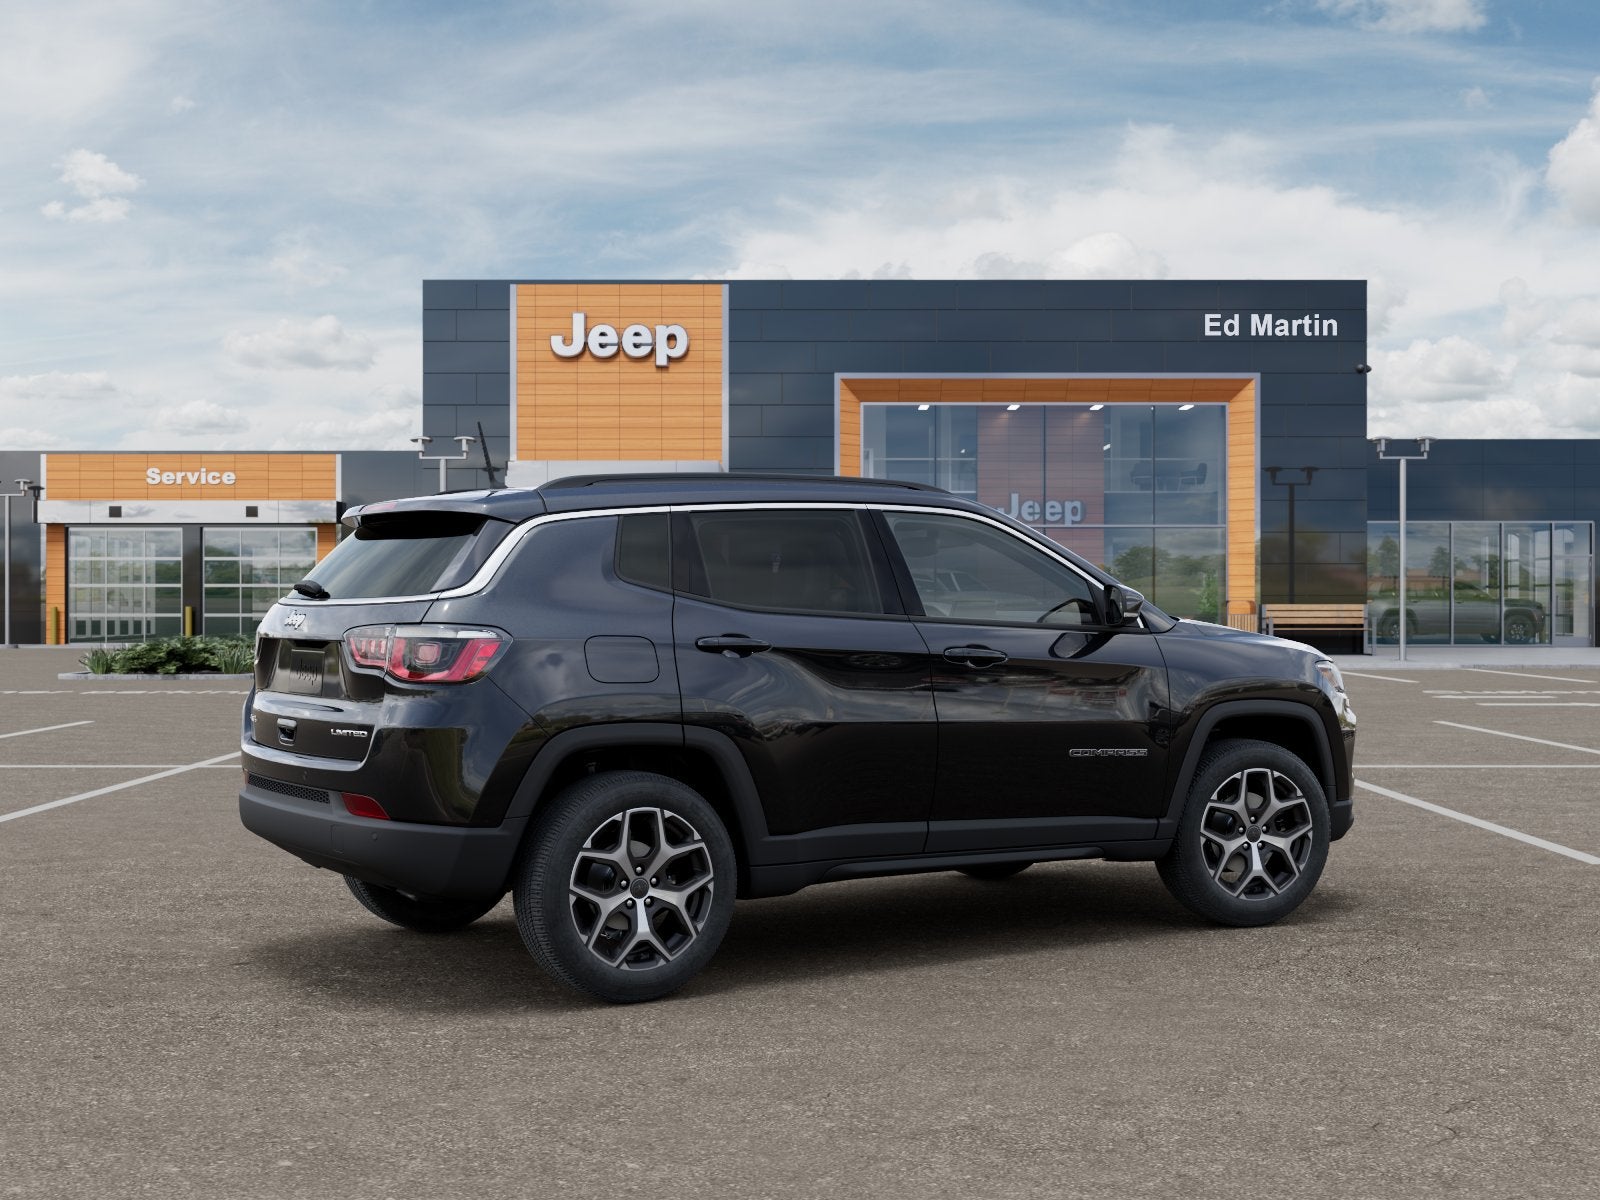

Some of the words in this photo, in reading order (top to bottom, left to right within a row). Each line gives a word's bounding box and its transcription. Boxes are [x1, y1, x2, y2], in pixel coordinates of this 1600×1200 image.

[1204, 313, 1240, 337] Ed
[1250, 313, 1338, 337] Martin
[550, 312, 689, 368] Jeep
[146, 467, 237, 485] Service
[997, 493, 1084, 526] Jeep
[330, 728, 368, 738] LIMITED
[1069, 748, 1148, 757] COMPASS
